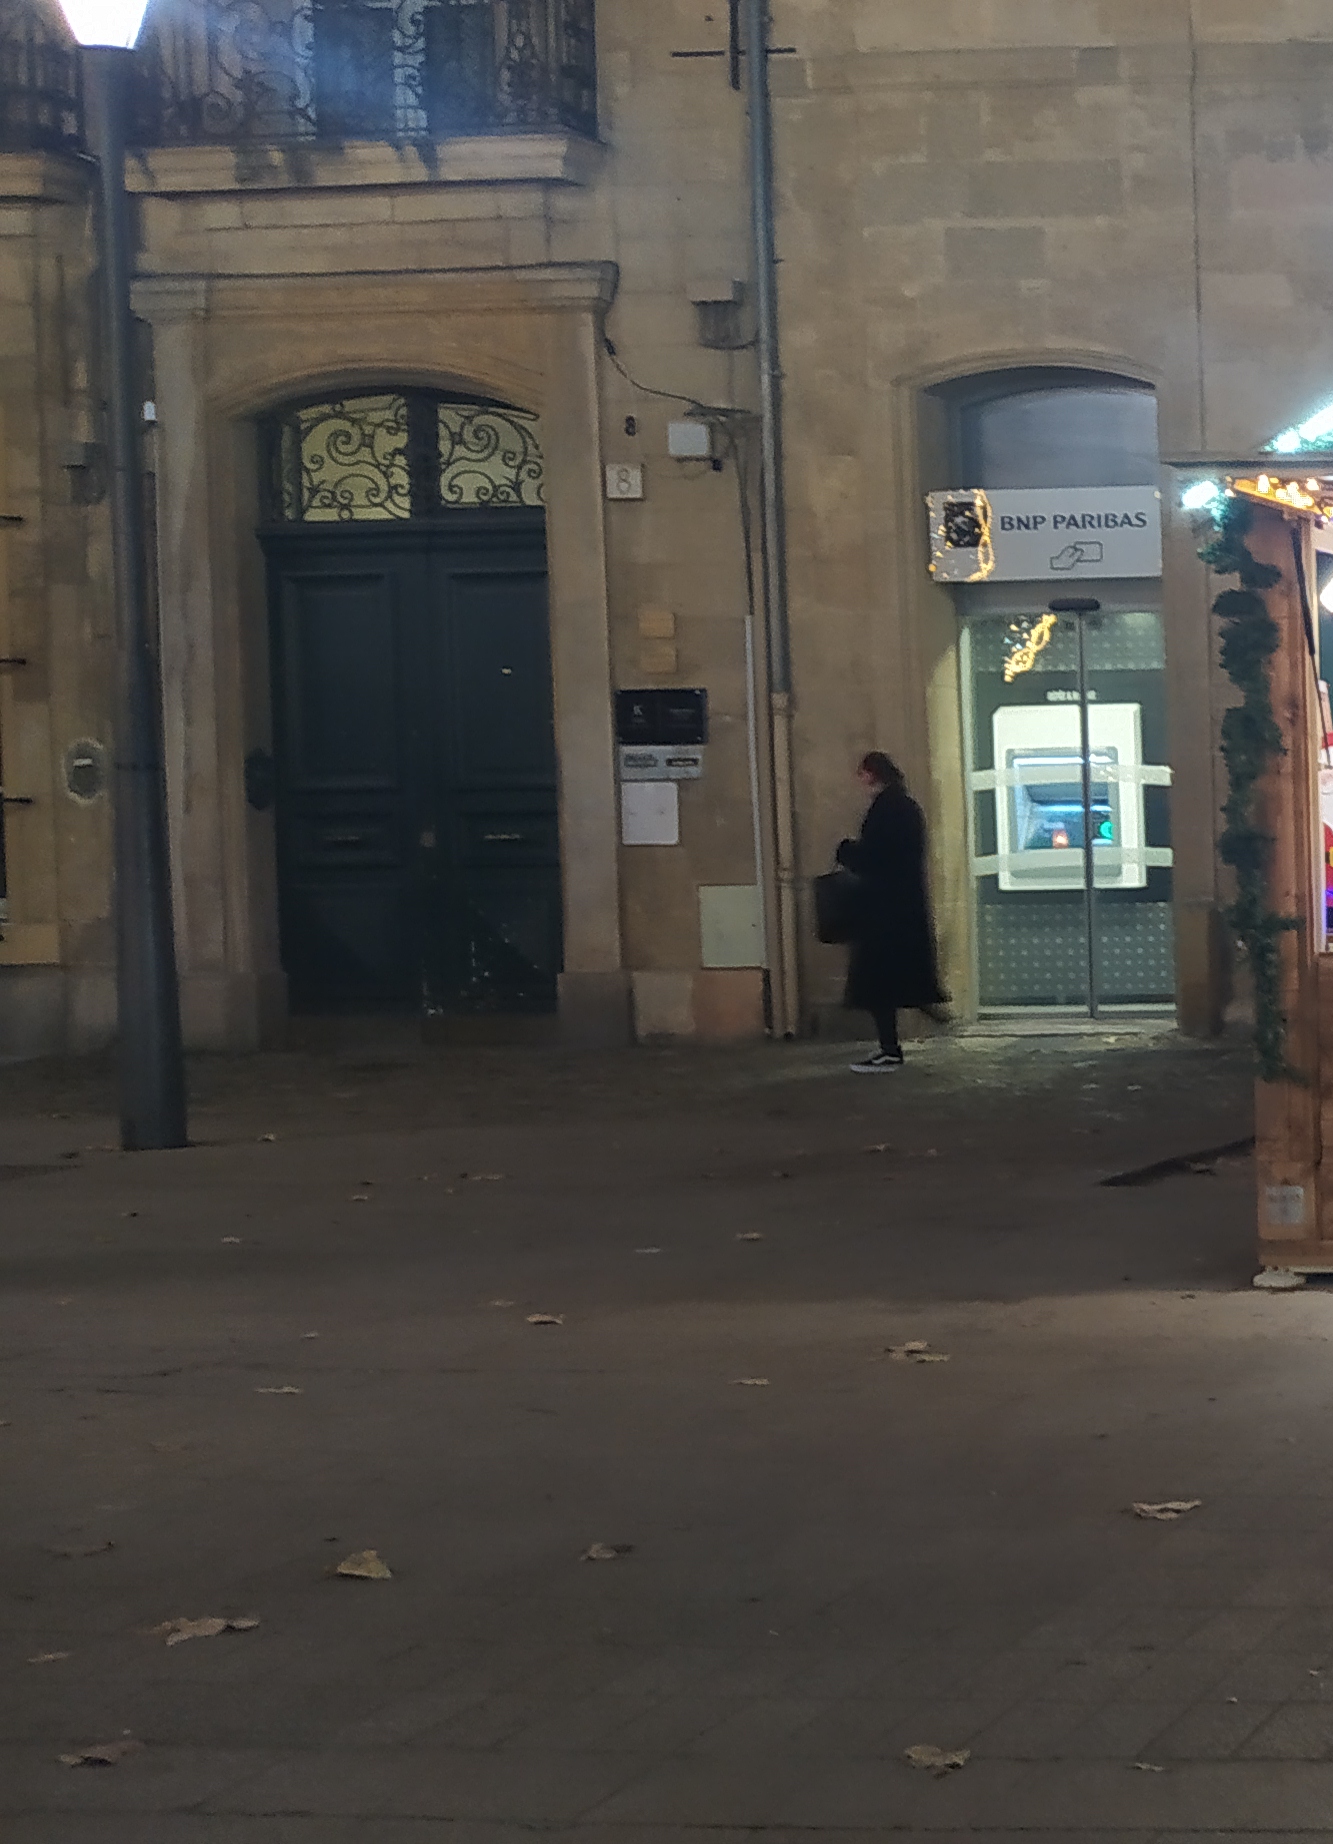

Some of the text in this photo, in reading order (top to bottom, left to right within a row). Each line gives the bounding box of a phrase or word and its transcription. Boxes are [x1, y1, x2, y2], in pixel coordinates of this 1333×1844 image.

[616, 468, 632, 495] 8
[1000, 511, 1148, 532] BNP PARIBAS
